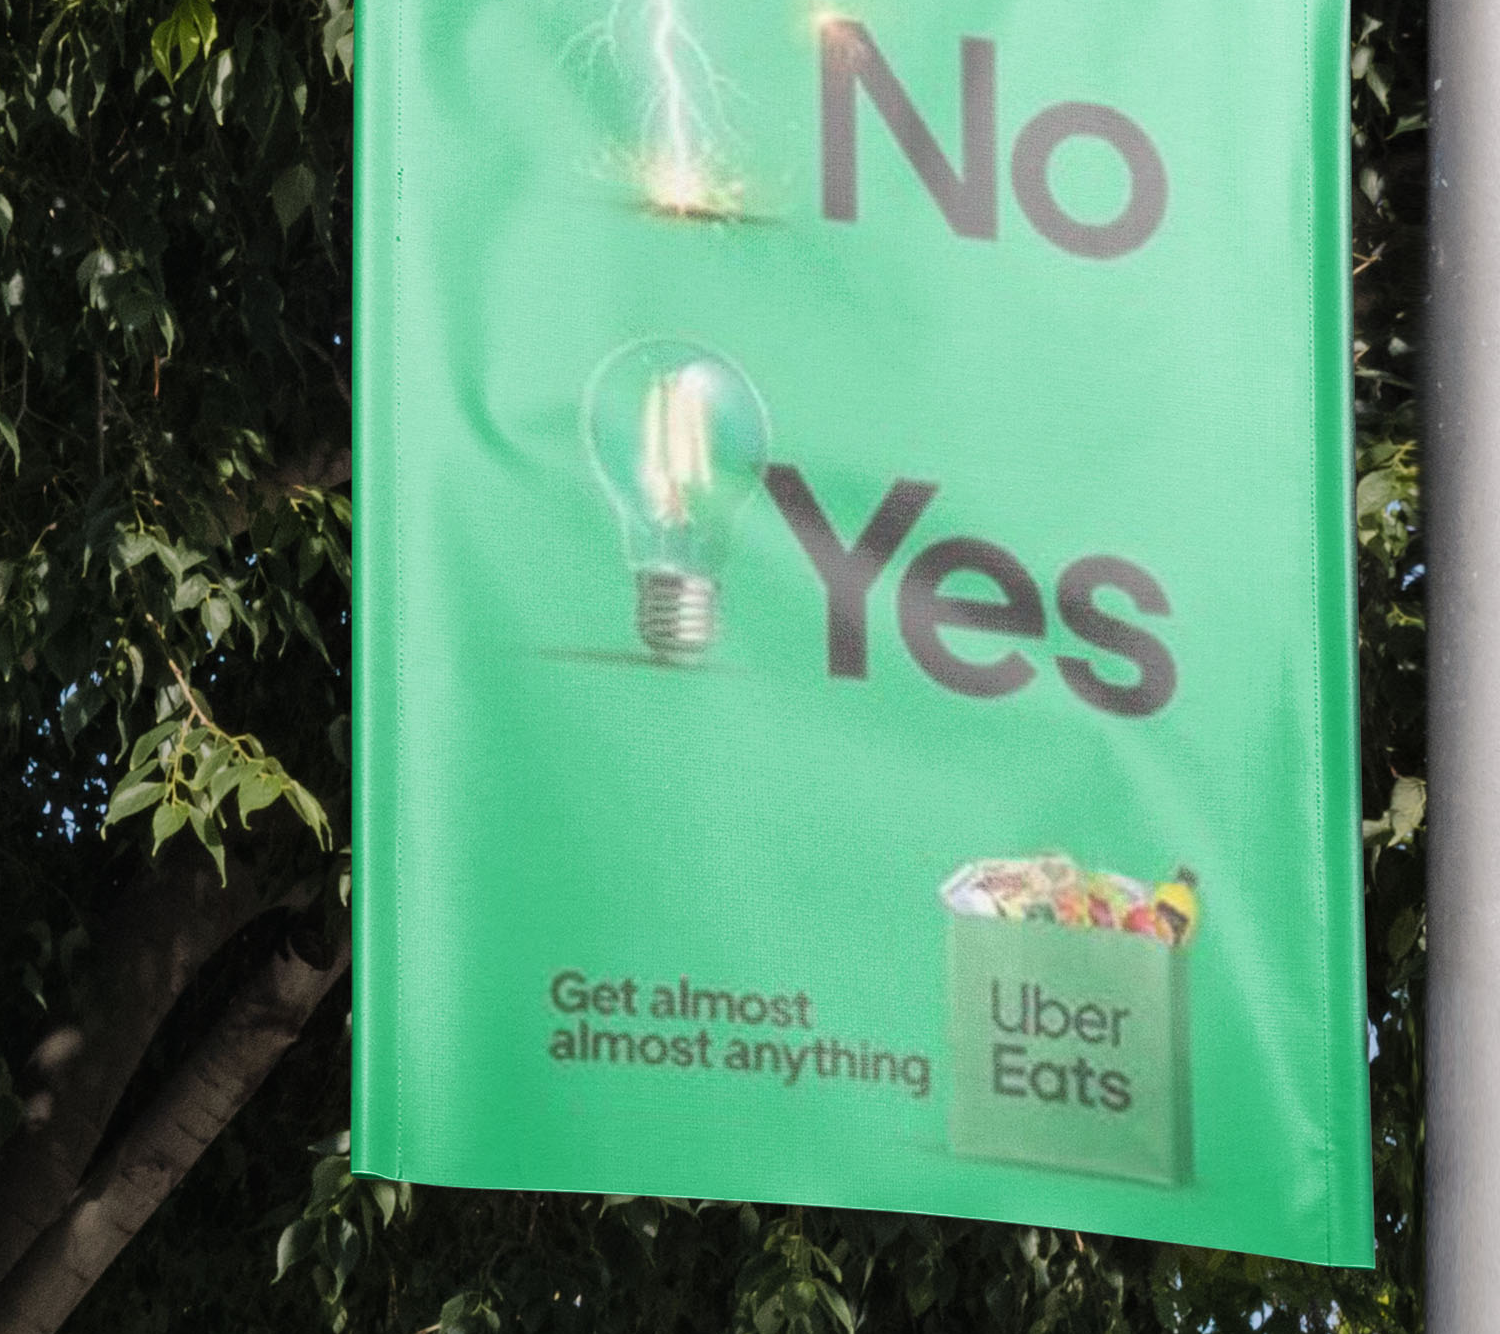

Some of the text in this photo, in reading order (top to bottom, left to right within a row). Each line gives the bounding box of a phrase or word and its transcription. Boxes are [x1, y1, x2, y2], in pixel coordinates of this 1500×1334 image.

[818, 18, 1169, 261] No
[762, 463, 1180, 719] Yes
[549, 970, 813, 1030] Get almost
[989, 977, 1132, 1048] Uber
[548, 1020, 932, 1097] almost anything
[991, 1044, 1134, 1113] Eats
